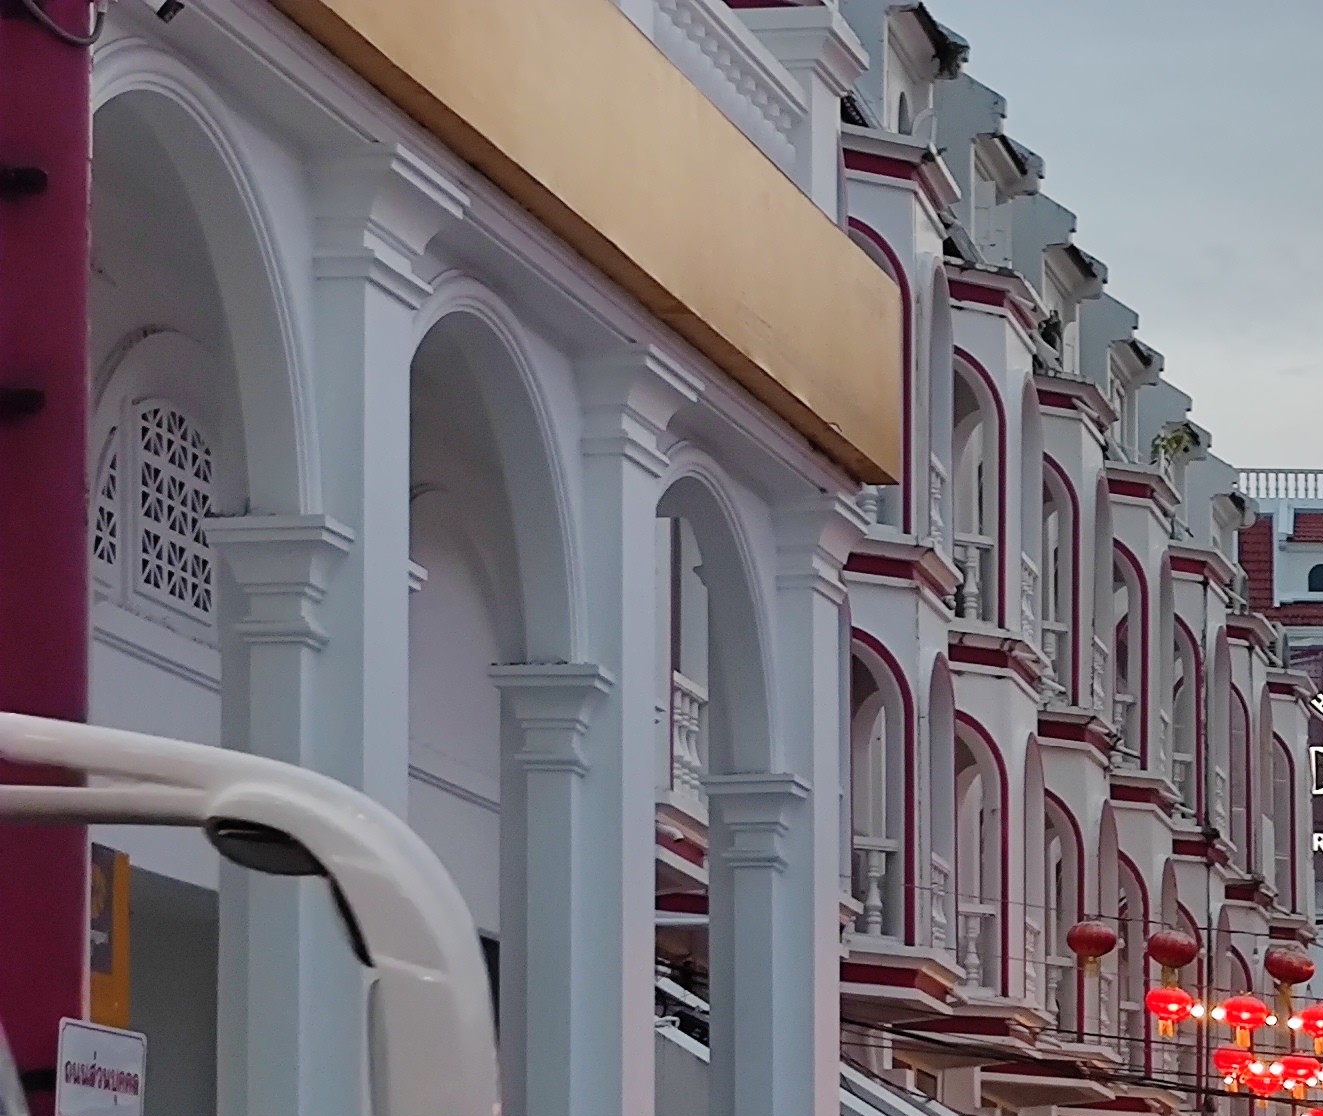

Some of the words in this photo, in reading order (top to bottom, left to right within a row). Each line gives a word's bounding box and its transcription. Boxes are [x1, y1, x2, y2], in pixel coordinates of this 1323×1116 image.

[65, 1051, 139, 1105] ถนนส่วนบุคคล
